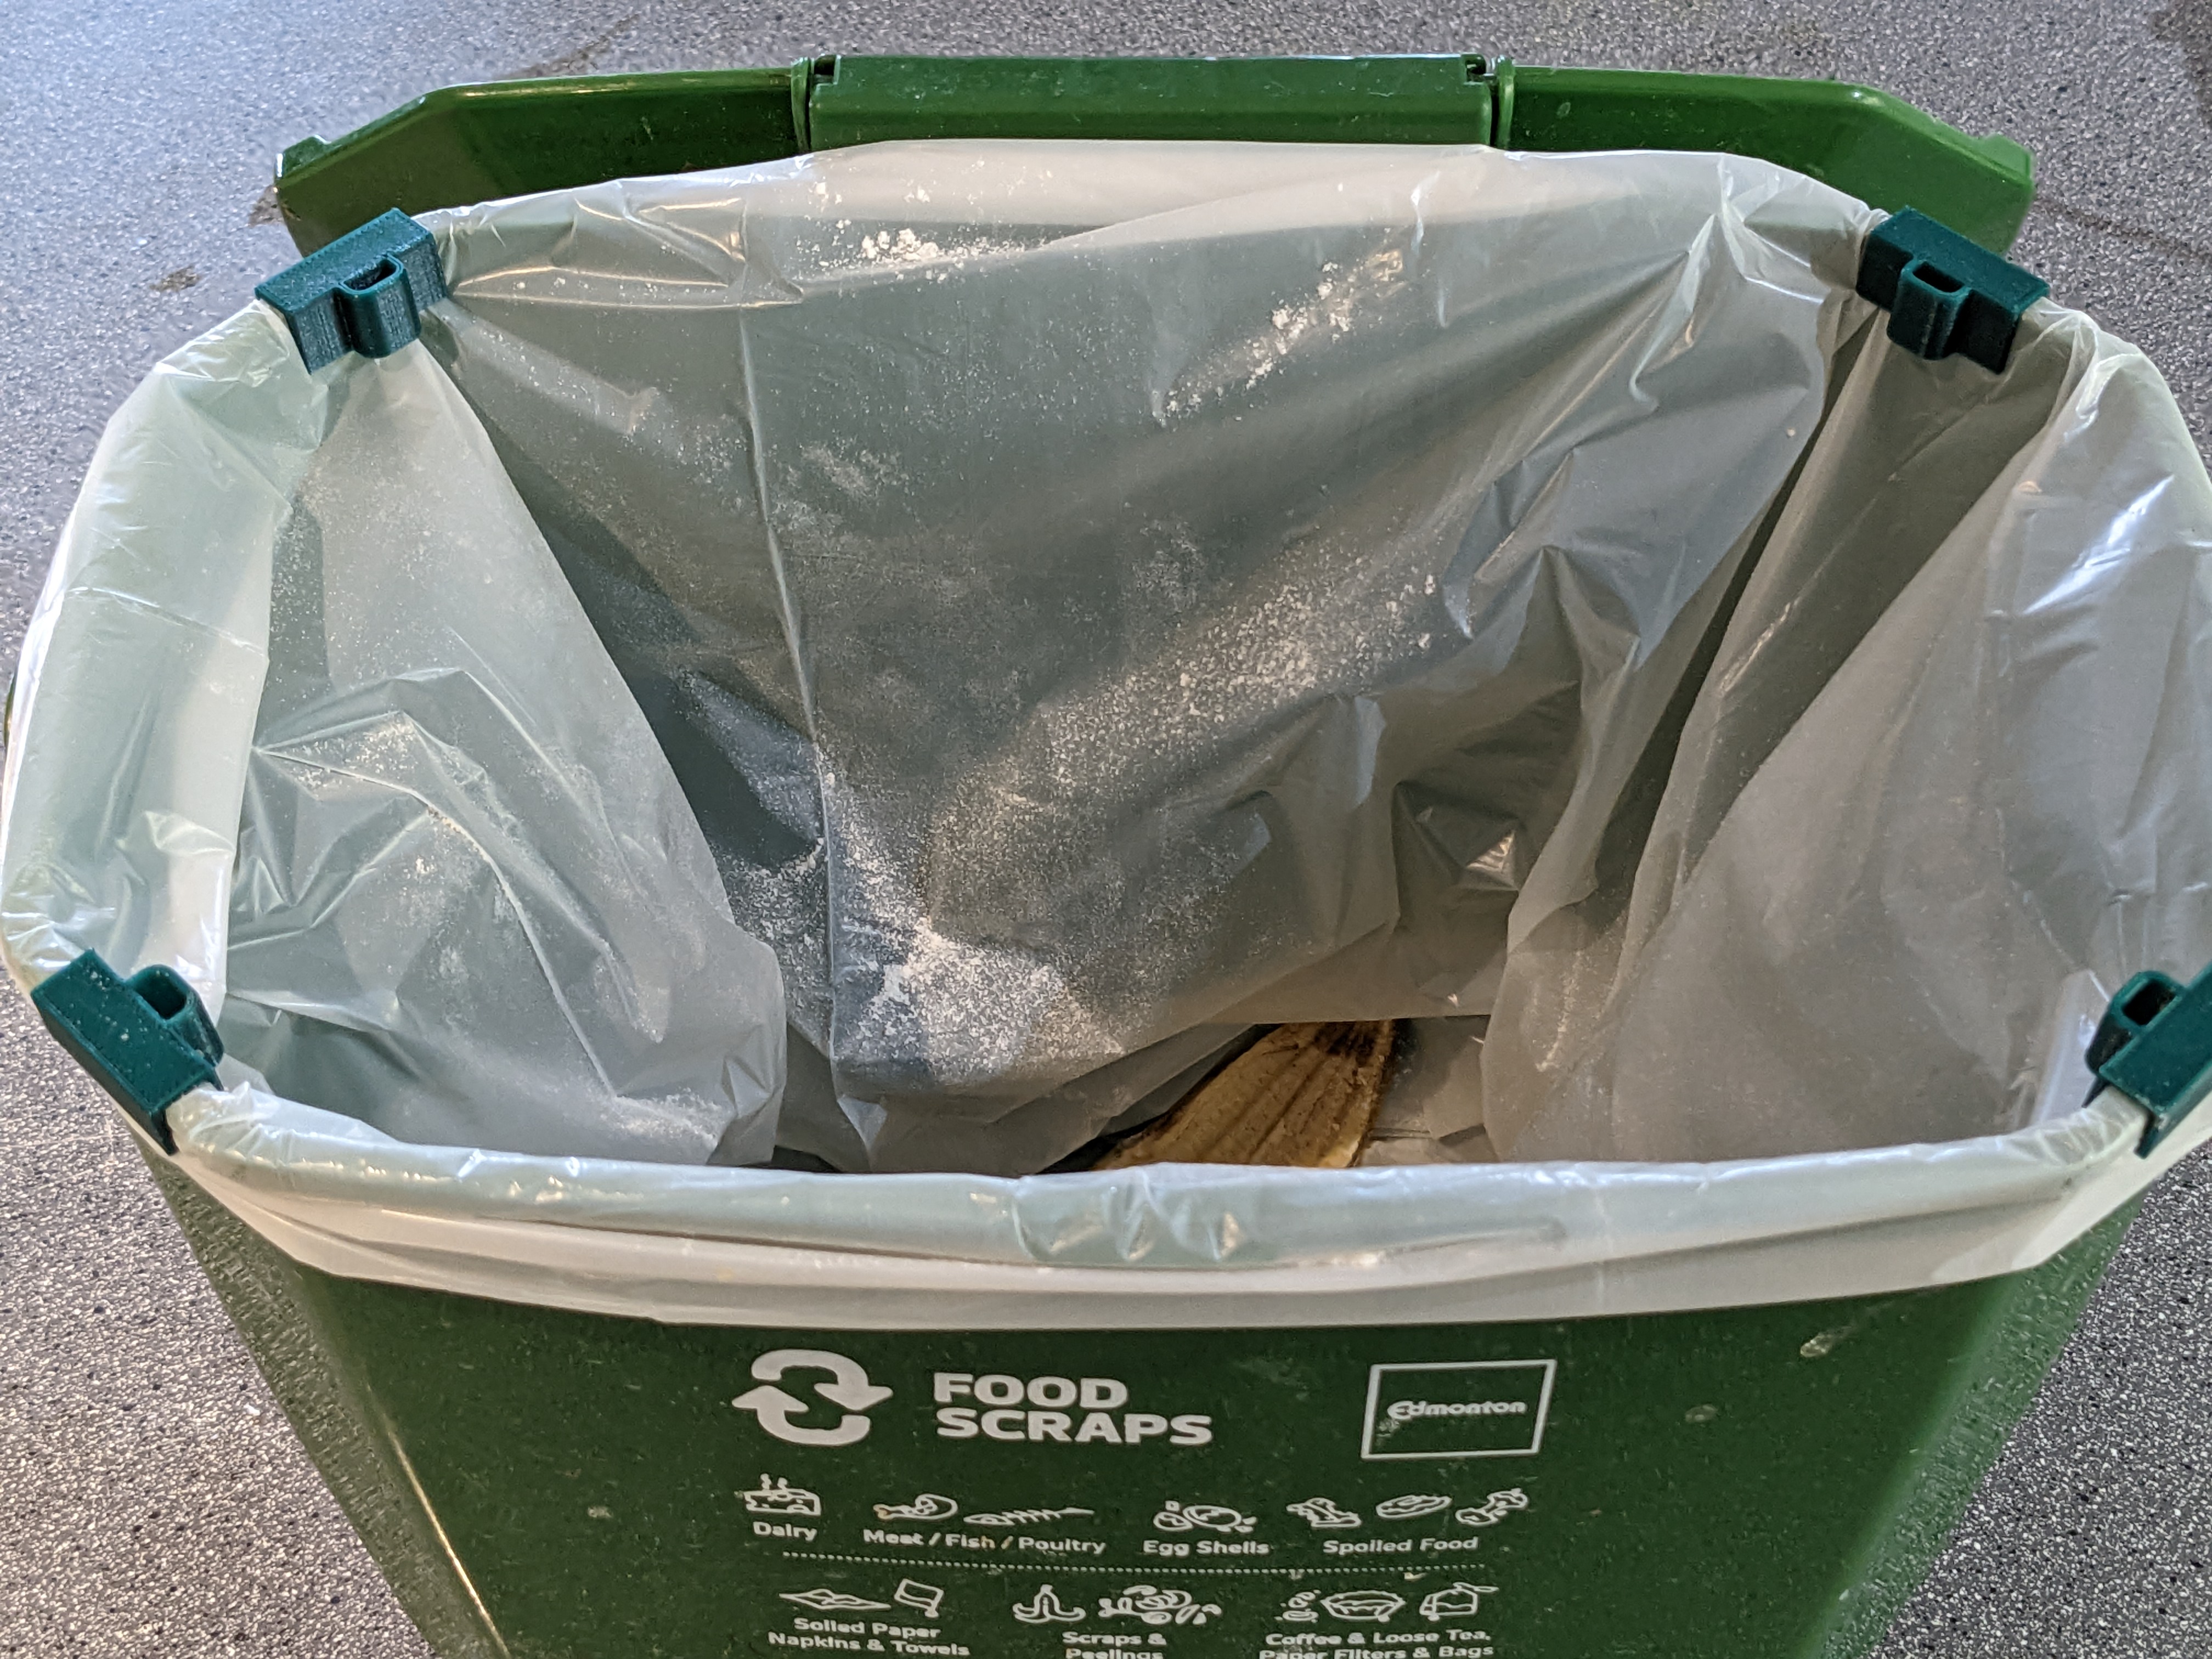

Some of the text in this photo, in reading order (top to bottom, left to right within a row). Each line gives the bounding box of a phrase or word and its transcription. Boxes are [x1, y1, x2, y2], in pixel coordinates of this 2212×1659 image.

[934, 1373, 1127, 1409] FOOD
[1387, 1401, 1526, 1420] Edmonton
[936, 1408, 1212, 1446] SCRAPS
[753, 1521, 817, 1541] Dairy
[863, 1529, 1105, 1554] Meat / Fish / Poultry
[1143, 1540, 1269, 1556] Egg Shells
[1323, 1537, 1478, 1555] Spoiled Food
[794, 1618, 940, 1639] Soiled Paper
[768, 1631, 970, 1656] Napkins & Towels
[1062, 1632, 1167, 1647] Scraps &
[1266, 1633, 1342, 1645] Coffee
[1347, 1632, 1365, 1644] &
[1373, 1632, 1440, 1644] Loose
[1334, 1649, 1407, 1659] Filters
[1412, 1647, 1430, 1658] &
[1438, 1646, 1494, 1658] Bags
